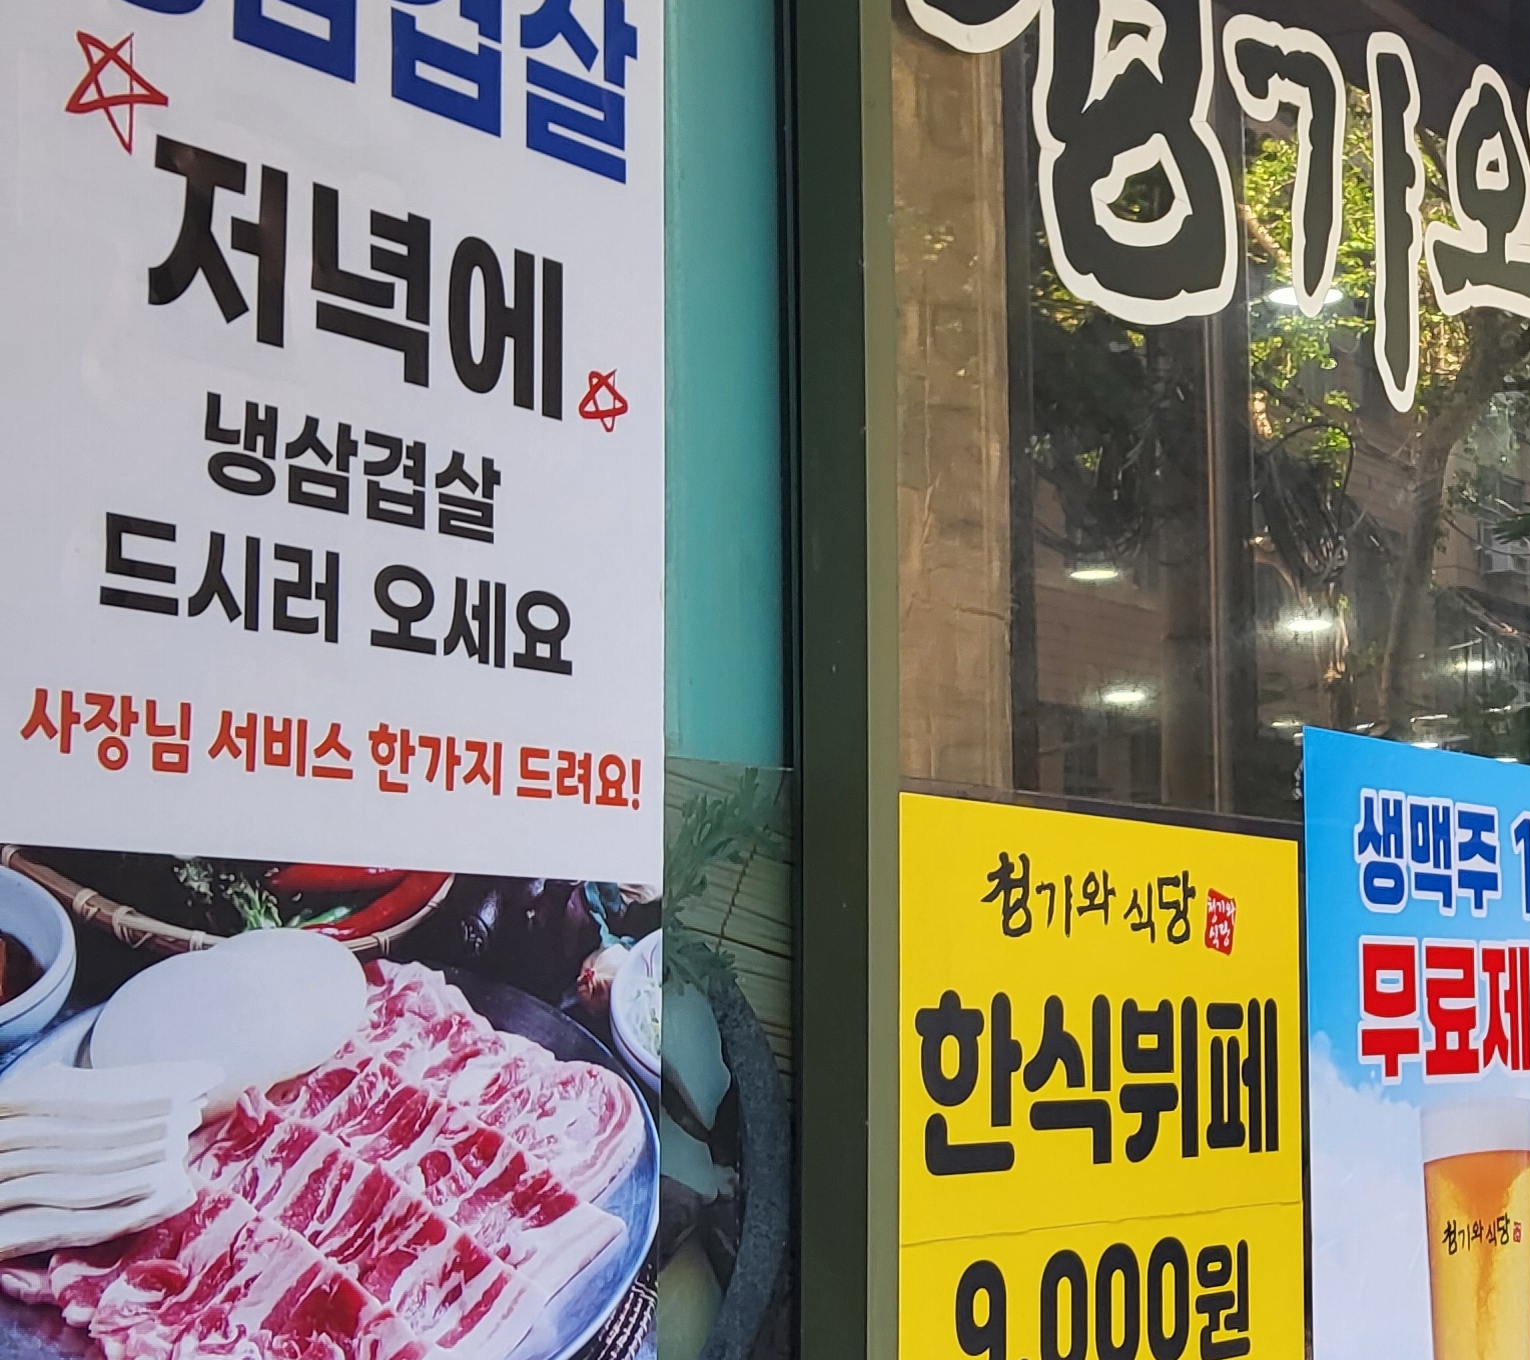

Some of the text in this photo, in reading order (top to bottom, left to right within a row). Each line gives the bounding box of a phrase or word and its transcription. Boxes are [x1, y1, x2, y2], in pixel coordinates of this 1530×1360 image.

[148, 134, 563, 421] 저녁에
[204, 391, 501, 544] 냉삼겹살
[100, 512, 573, 676] 드시러 오세요
[20, 688, 642, 810] 사장님 서비스 한가지 드려요!
[1123, 870, 1196, 943] 식당
[1356, 788, 1500, 919] 생맥주
[914, 990, 1279, 1177] 한식뷔페
[1486, 1212, 1510, 1247] 식당
